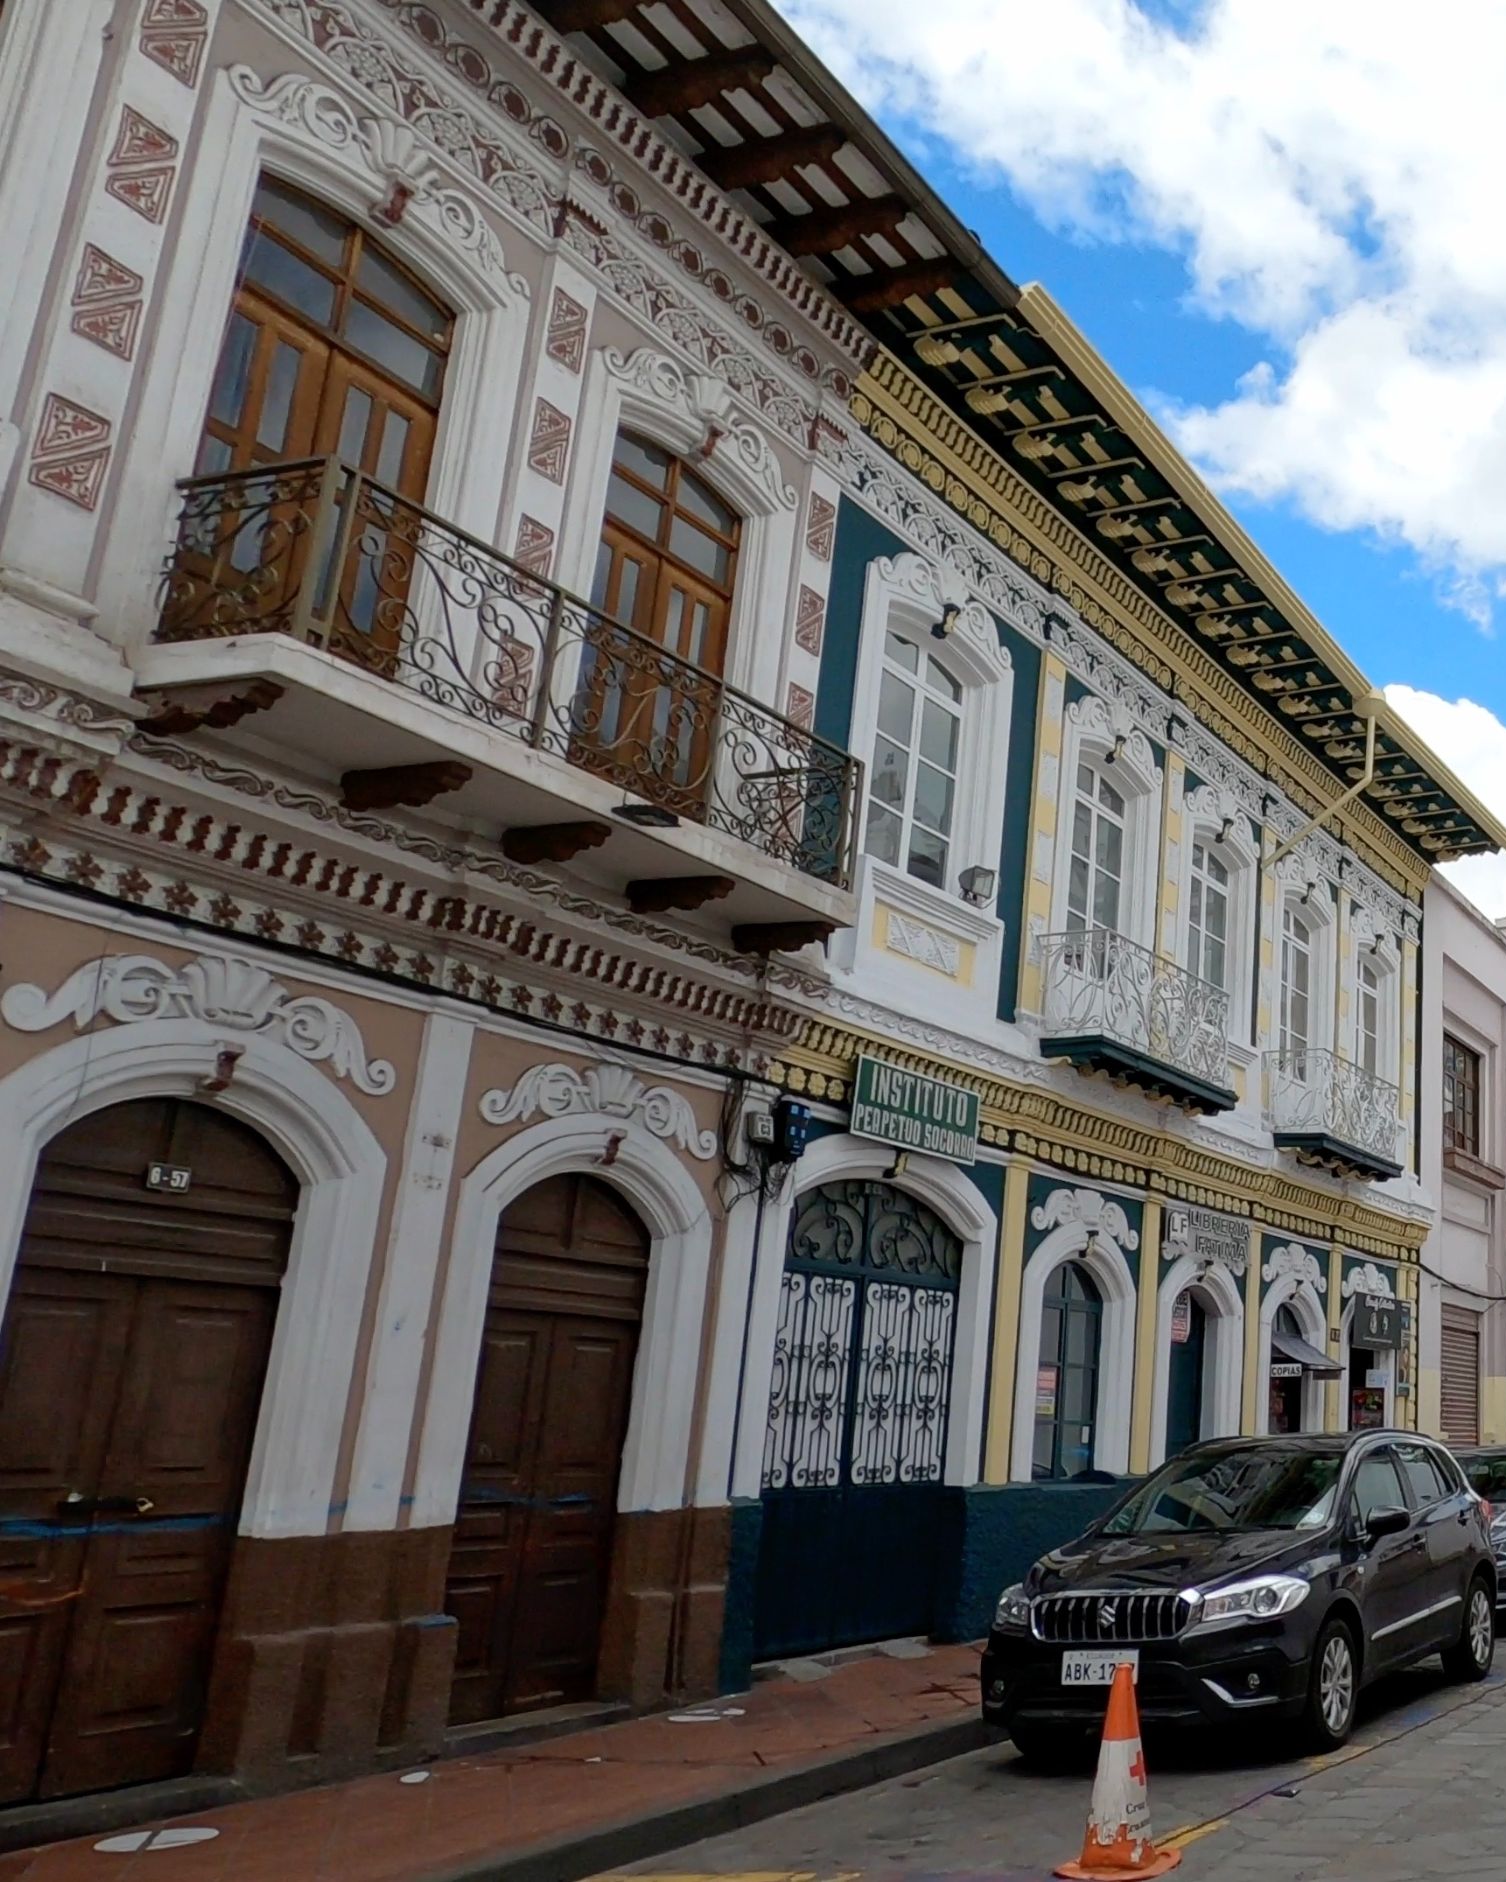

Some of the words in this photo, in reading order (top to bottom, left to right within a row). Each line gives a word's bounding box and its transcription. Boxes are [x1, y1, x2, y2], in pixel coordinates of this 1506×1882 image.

[870, 1063, 968, 1127] INSTITUTO
[855, 1103, 921, 1146] PERPETUO
[923, 1122, 975, 1160] SOCORRO
[1171, 1215, 1188, 1234] LF
[1189, 1208, 1250, 1240] LIBRERIA
[1271, 1365, 1301, 1377] COPIAS
